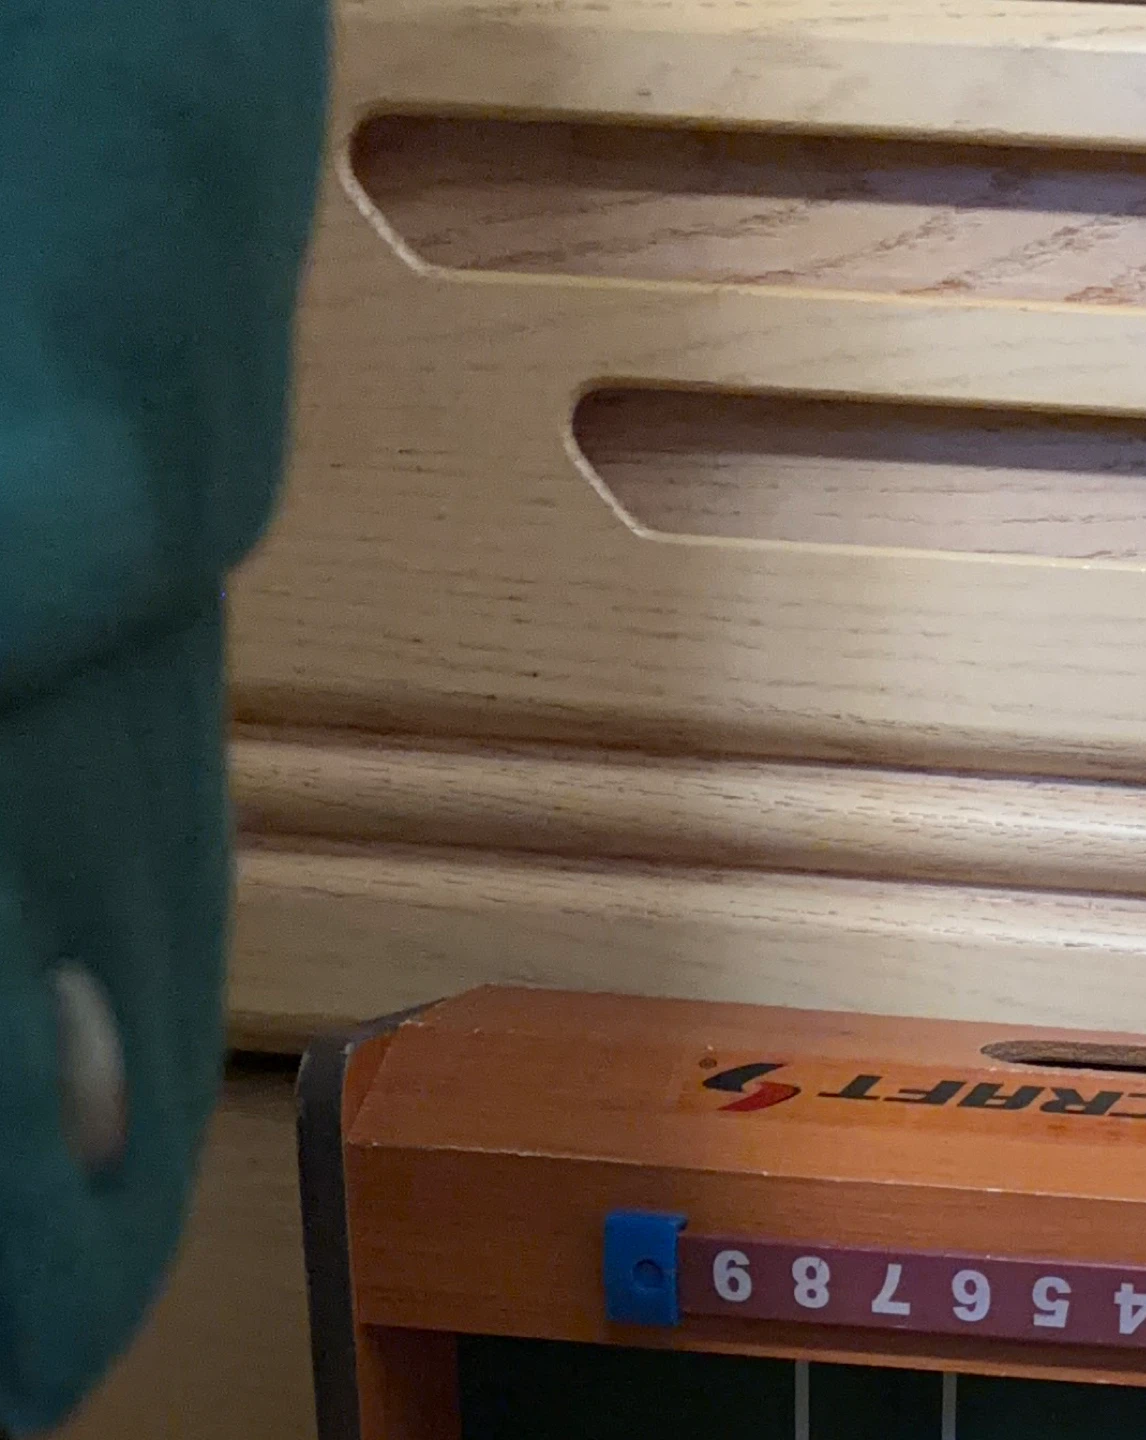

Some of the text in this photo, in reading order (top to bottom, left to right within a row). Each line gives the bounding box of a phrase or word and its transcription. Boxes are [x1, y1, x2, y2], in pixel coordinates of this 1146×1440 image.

[712, 1249, 752, 1302] 9
[792, 1256, 830, 1308] 8
[871, 1263, 911, 1316] 7
[951, 1269, 991, 1322] 6
[1032, 1276, 1072, 1328] 5
